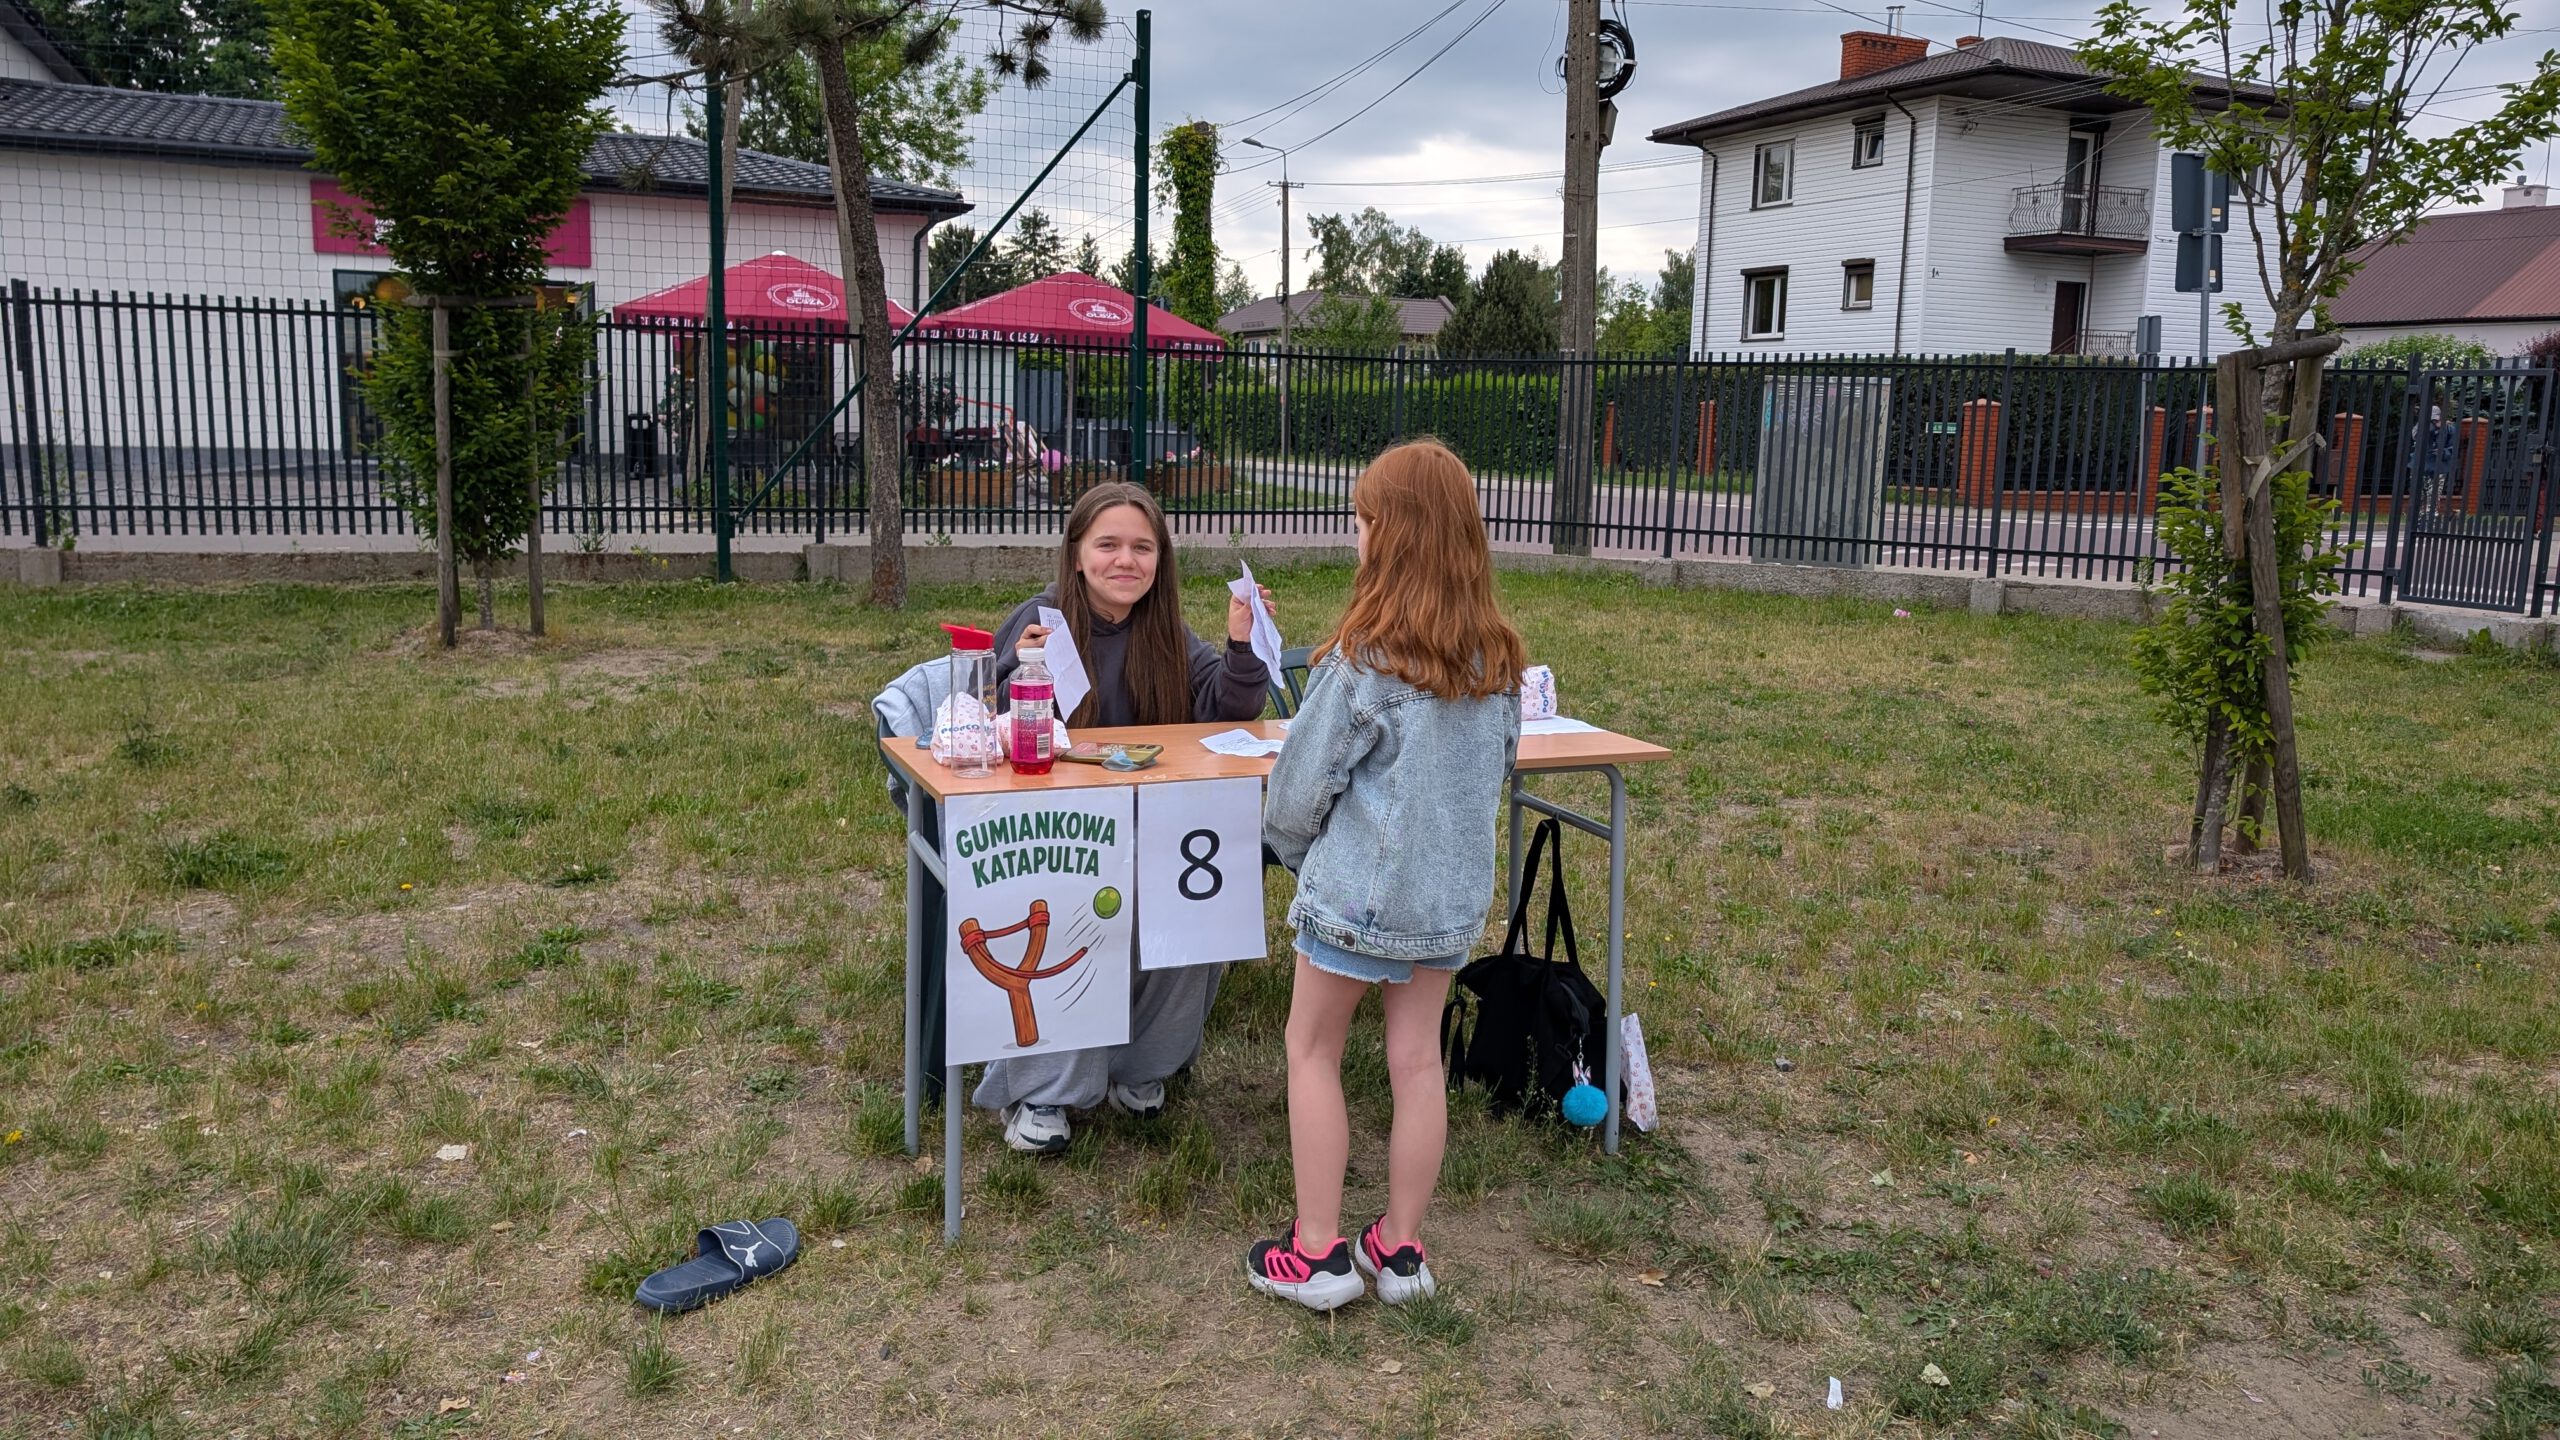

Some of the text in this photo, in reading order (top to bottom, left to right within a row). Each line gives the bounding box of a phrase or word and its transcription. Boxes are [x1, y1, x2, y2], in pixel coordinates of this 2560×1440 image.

[956, 811, 1117, 858] GUMIANKOWA
[971, 845, 1100, 888] KATAPULTA
[1177, 828, 1224, 901] 8
